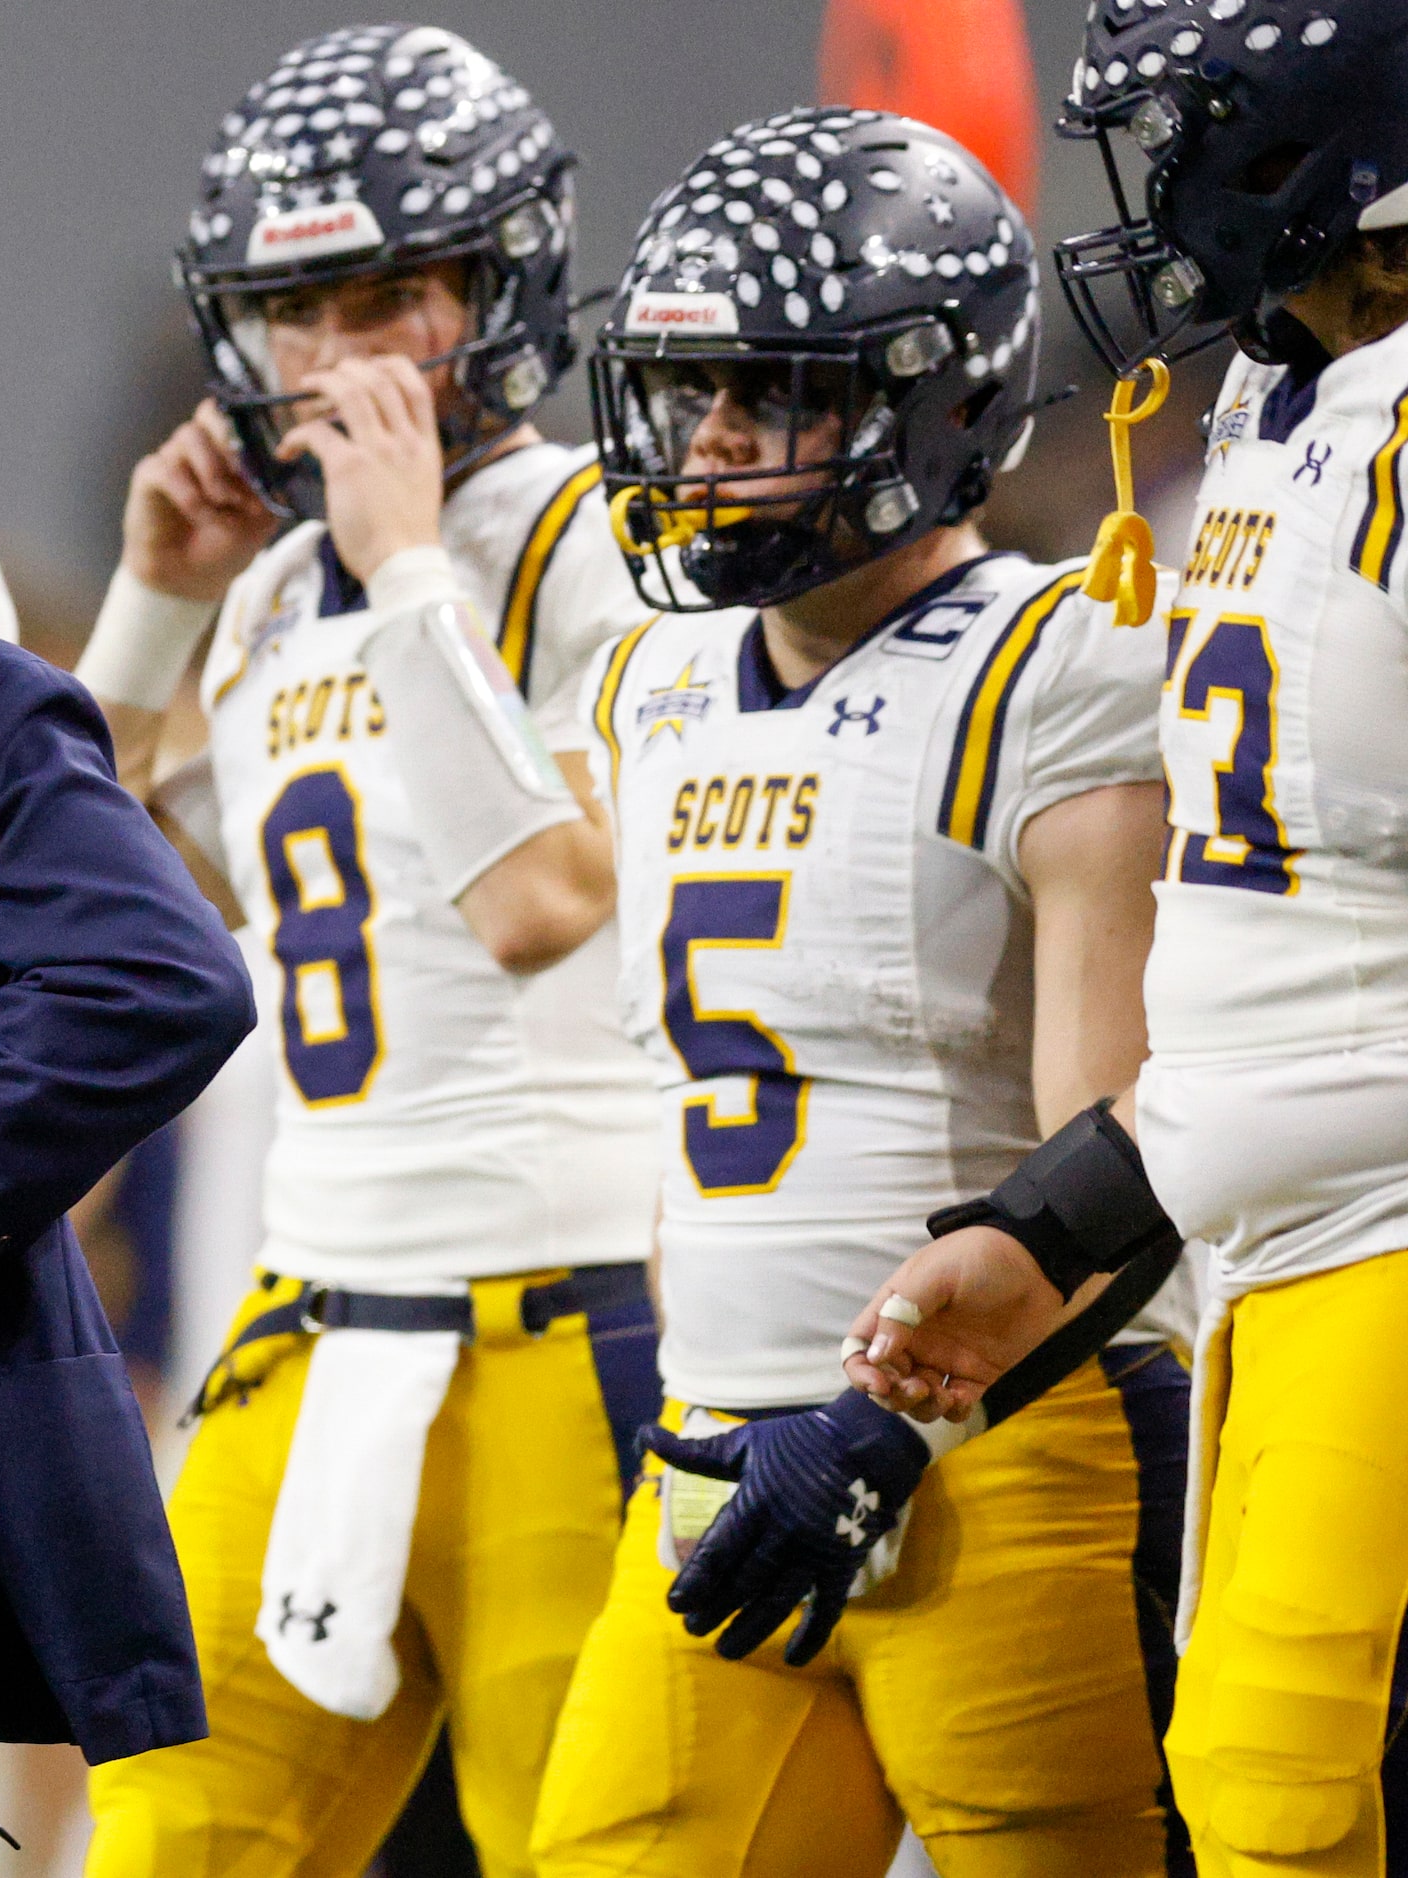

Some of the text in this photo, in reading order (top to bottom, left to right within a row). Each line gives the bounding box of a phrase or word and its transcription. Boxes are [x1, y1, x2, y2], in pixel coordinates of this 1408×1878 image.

[1183, 507, 1276, 591] SCOTS
[893, 601, 986, 645] C
[268, 671, 387, 760] SCOTS
[1162, 607, 1300, 896] 3
[667, 772, 821, 856] SCOTS
[261, 761, 385, 1110] 8
[660, 870, 813, 1199] 5
